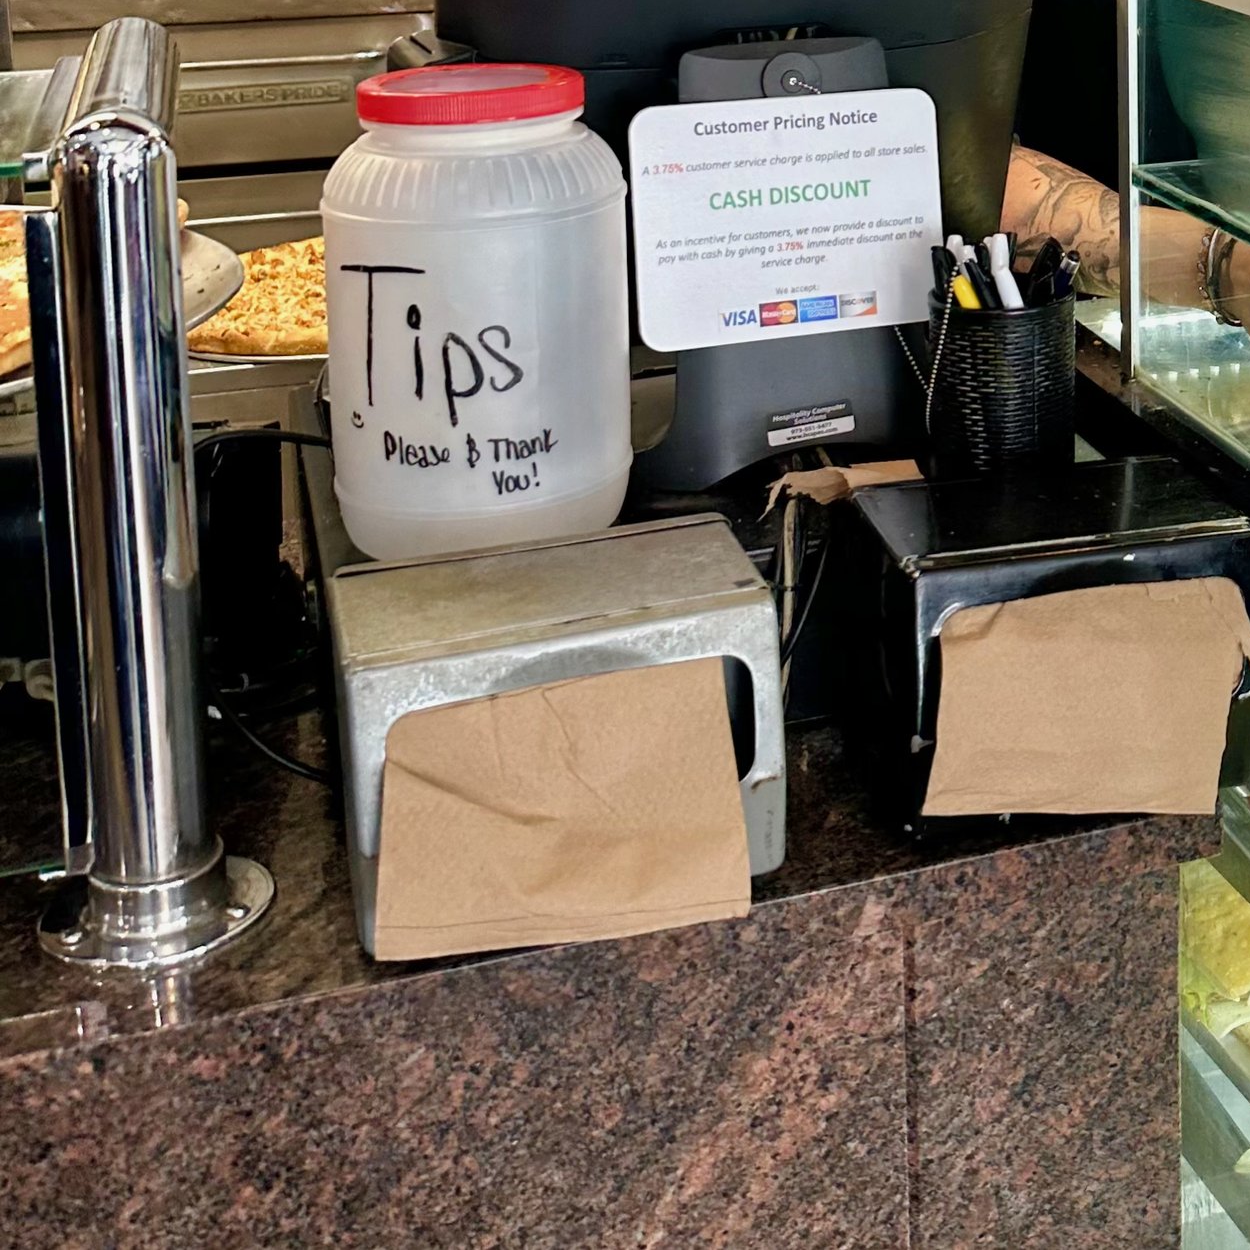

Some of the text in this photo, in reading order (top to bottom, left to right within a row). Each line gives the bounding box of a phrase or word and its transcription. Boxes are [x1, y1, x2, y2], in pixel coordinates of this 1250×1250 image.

[200, 84, 339, 107] BAKERS PRIDE
[694, 110, 878, 136] Customer Pricing Notice
[642, 166, 650, 176] A
[652, 163, 684, 175] 3.75%
[686, 160, 732, 172] customer
[734, 157, 767, 168] service
[770, 154, 803, 166] charge
[805, 153, 813, 163] is
[815, 149, 850, 163] applied
[852, 149, 862, 158] to
[864, 147, 876, 157] all
[878, 146, 901, 156] store
[709, 179, 871, 210] CASH DISCOUNT
[656, 215, 924, 249] As an incentive for customers, we now provide a discount to
[658, 230, 923, 265] pay with cash by giving a 3.75% immediate discount on the
[761, 257, 793, 269] service
[722, 309, 758, 327] VISA
[340, 264, 524, 428] Tips
[384, 430, 450, 468] Please
[488, 429, 559, 463] Thank
[492, 462, 541, 495] You!
